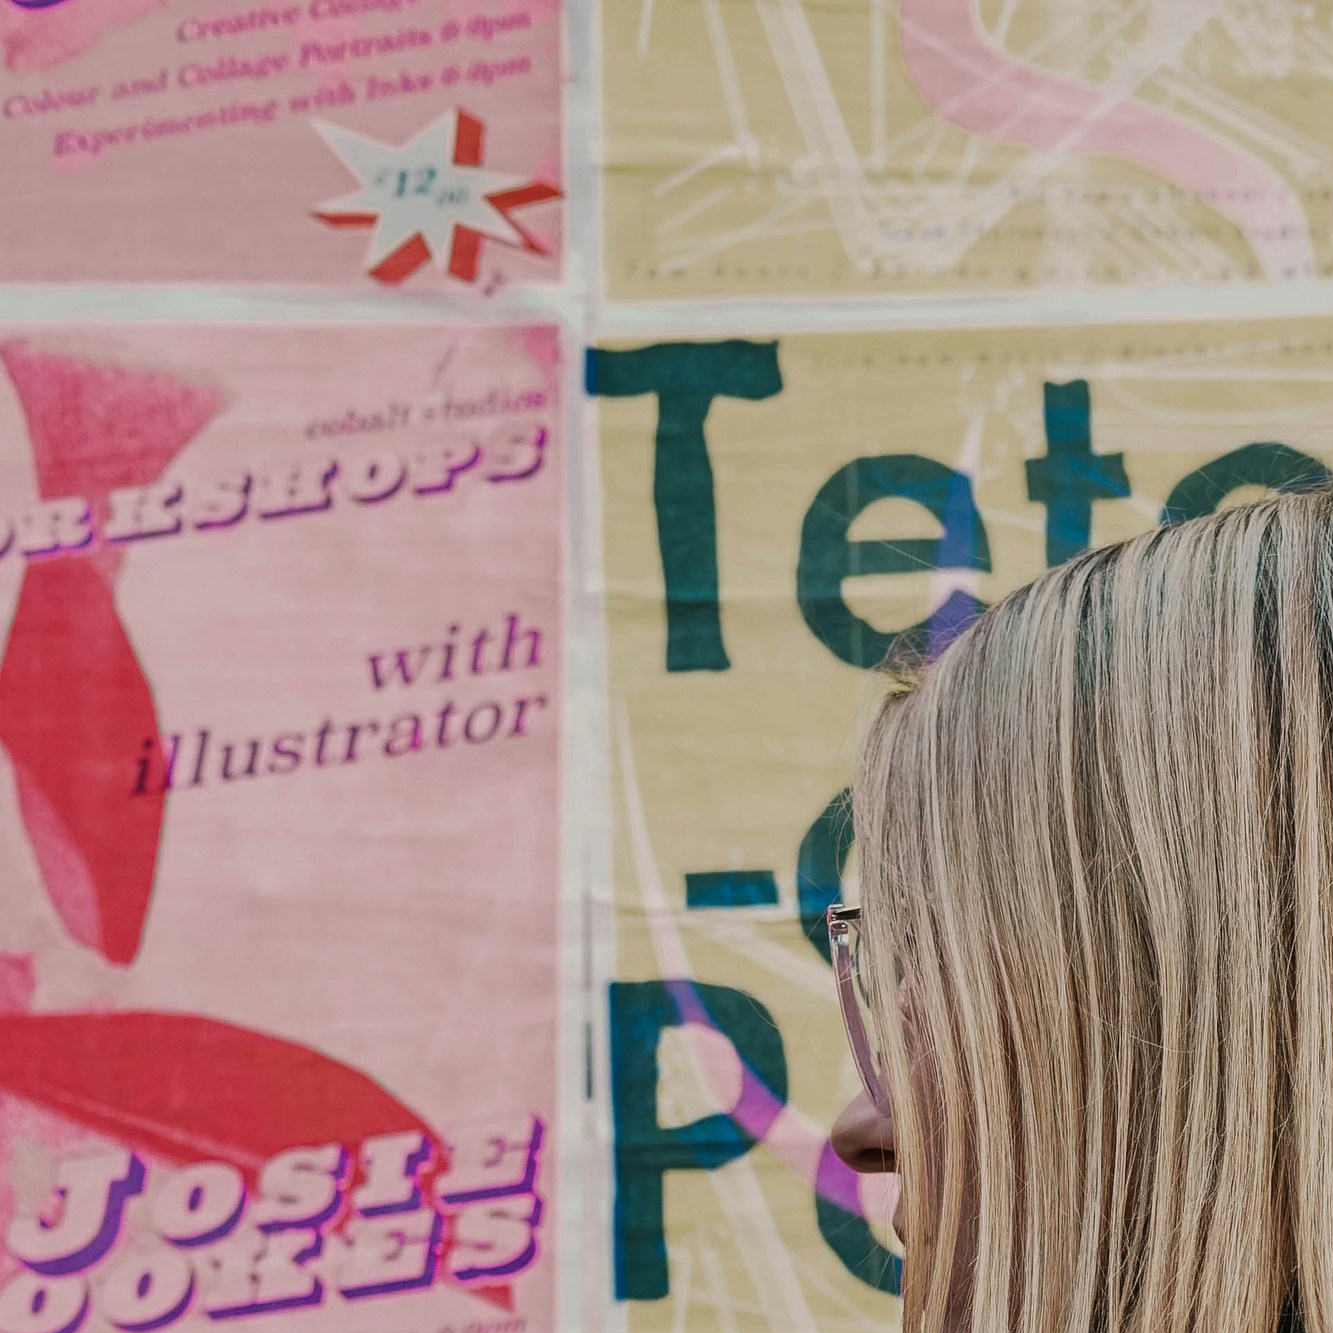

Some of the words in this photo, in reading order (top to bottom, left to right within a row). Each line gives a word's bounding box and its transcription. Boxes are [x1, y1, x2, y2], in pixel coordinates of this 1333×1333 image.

[367, 612, 546, 692] with
[129, 694, 550, 798] illustrator
[3, 1115, 547, 1276] JOSIE
